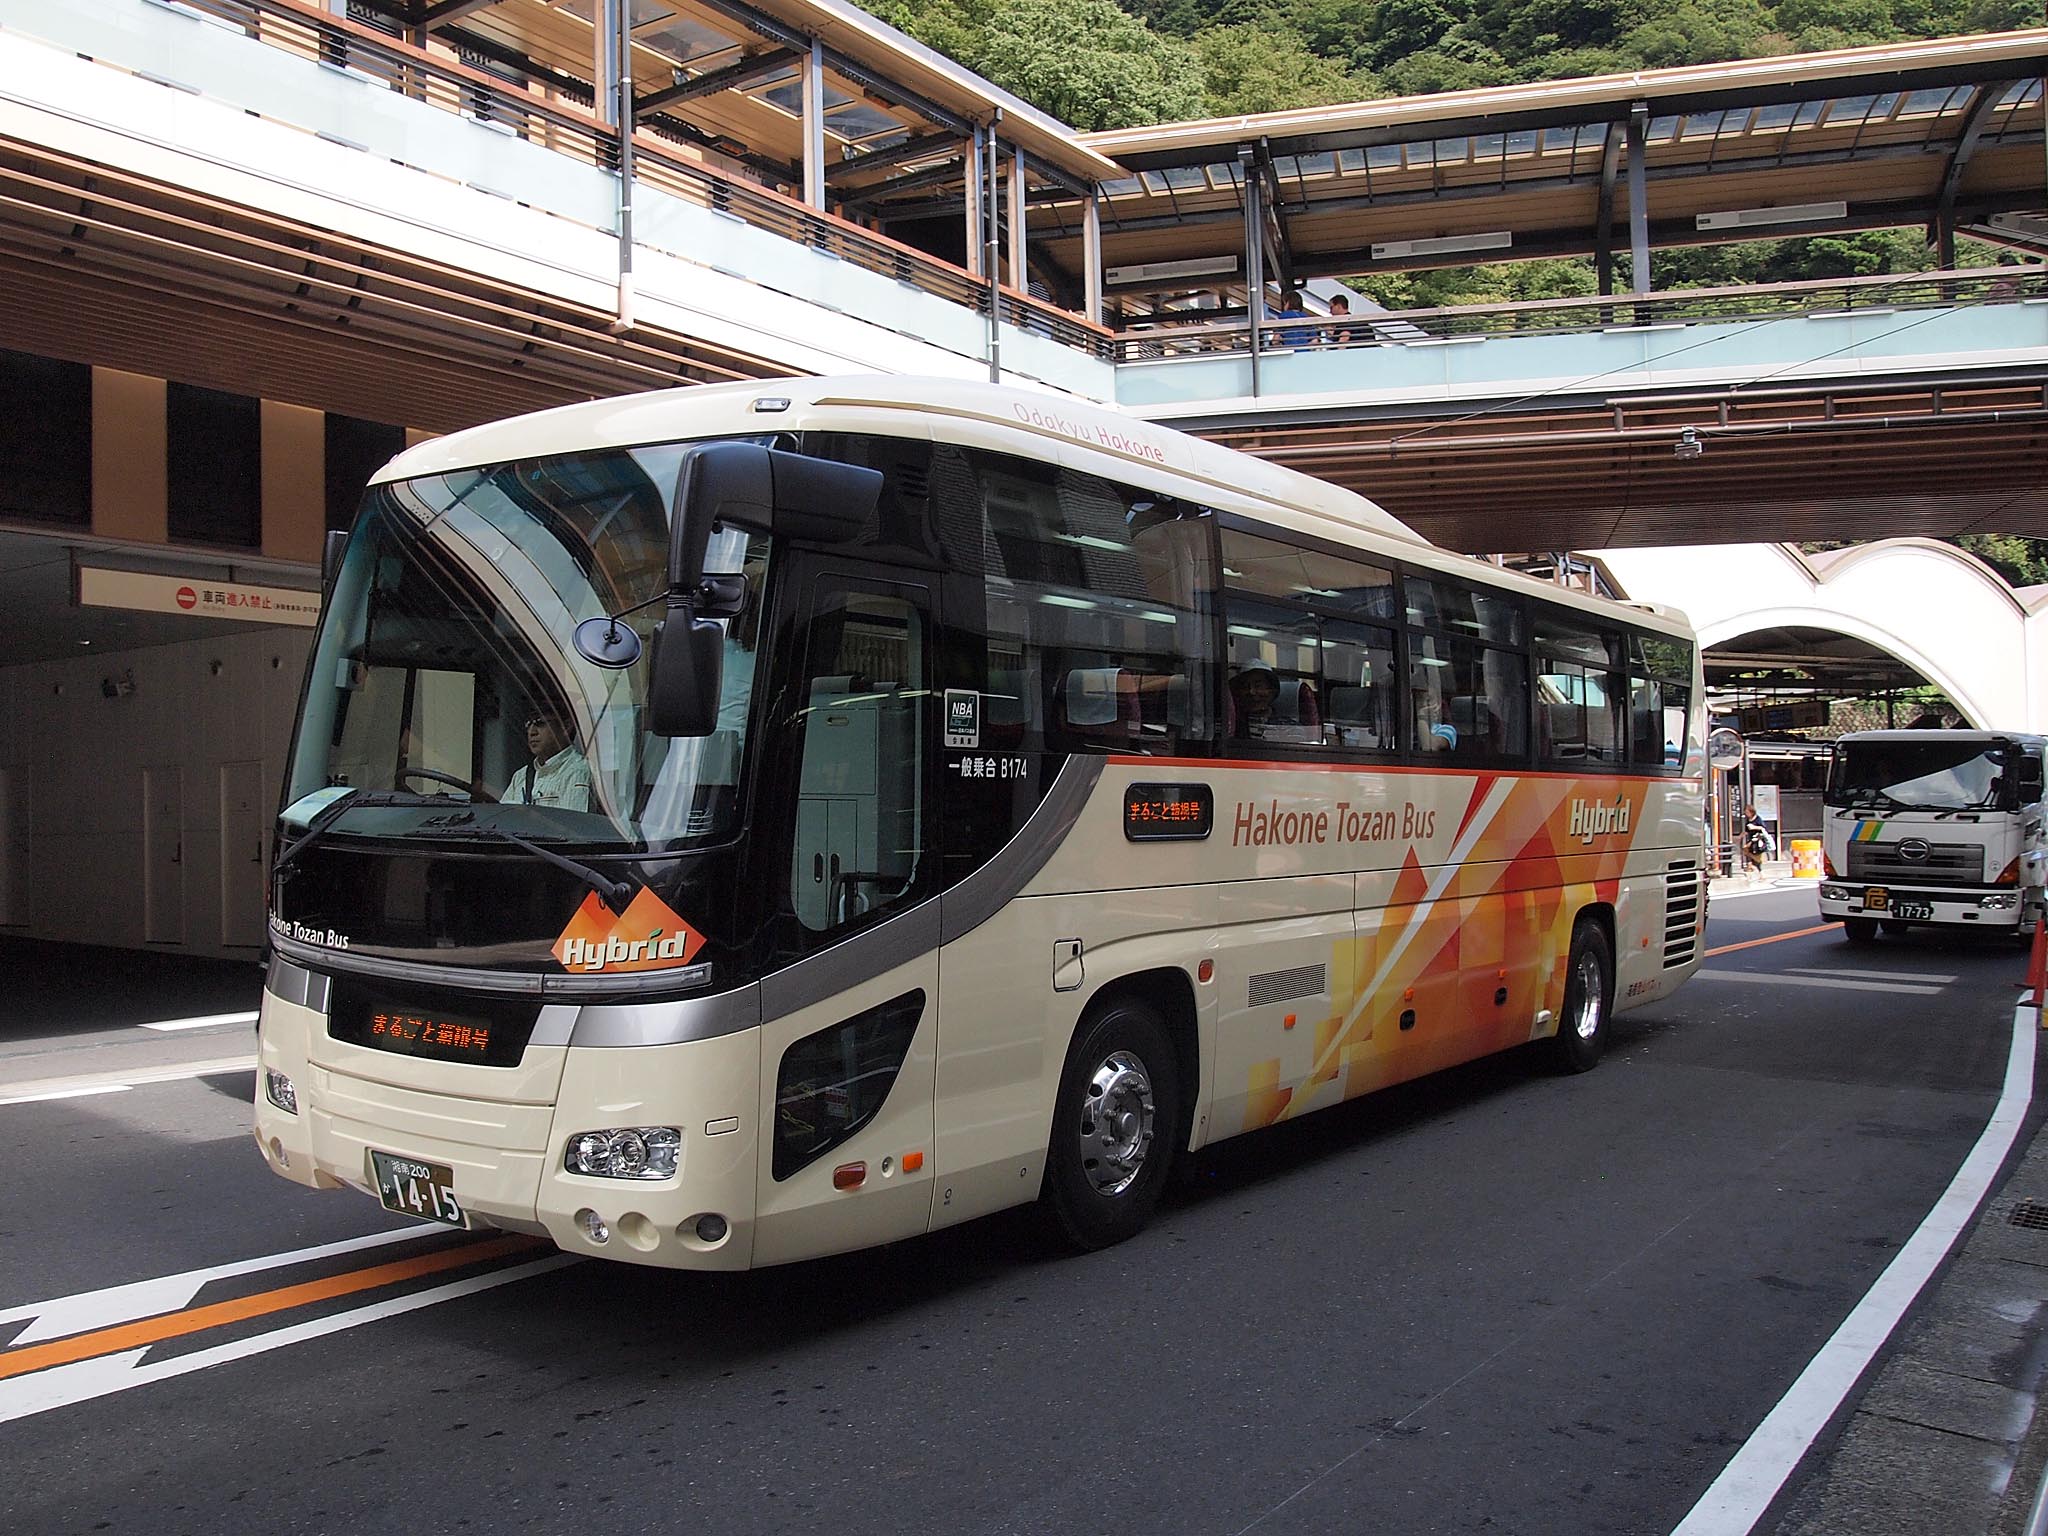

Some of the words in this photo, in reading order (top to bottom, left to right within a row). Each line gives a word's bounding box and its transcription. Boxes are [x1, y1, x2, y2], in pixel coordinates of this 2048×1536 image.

[1013, 402, 1091, 440] Odakyu
[1096, 426, 1164, 462] Hakone
[202, 590, 272, 610] 車両進入禁止
[952, 702, 973, 716] NBA
[949, 756, 997, 778] 一般乗合
[1001, 758, 1027, 778] B174
[1130, 801, 1201, 821] まるごと箱根号
[1570, 796, 1631, 845] Hybrid
[1232, 800, 1328, 847] Hakone
[1336, 802, 1396, 842] Tozan
[1402, 802, 1436, 840] Bus
[1865, 887, 1887, 909] 危
[293, 920, 325, 944] Tozan
[327, 929, 350, 949] Bus
[562, 930, 687, 970] Hybrid
[410, 1164, 430, 1180] 200
